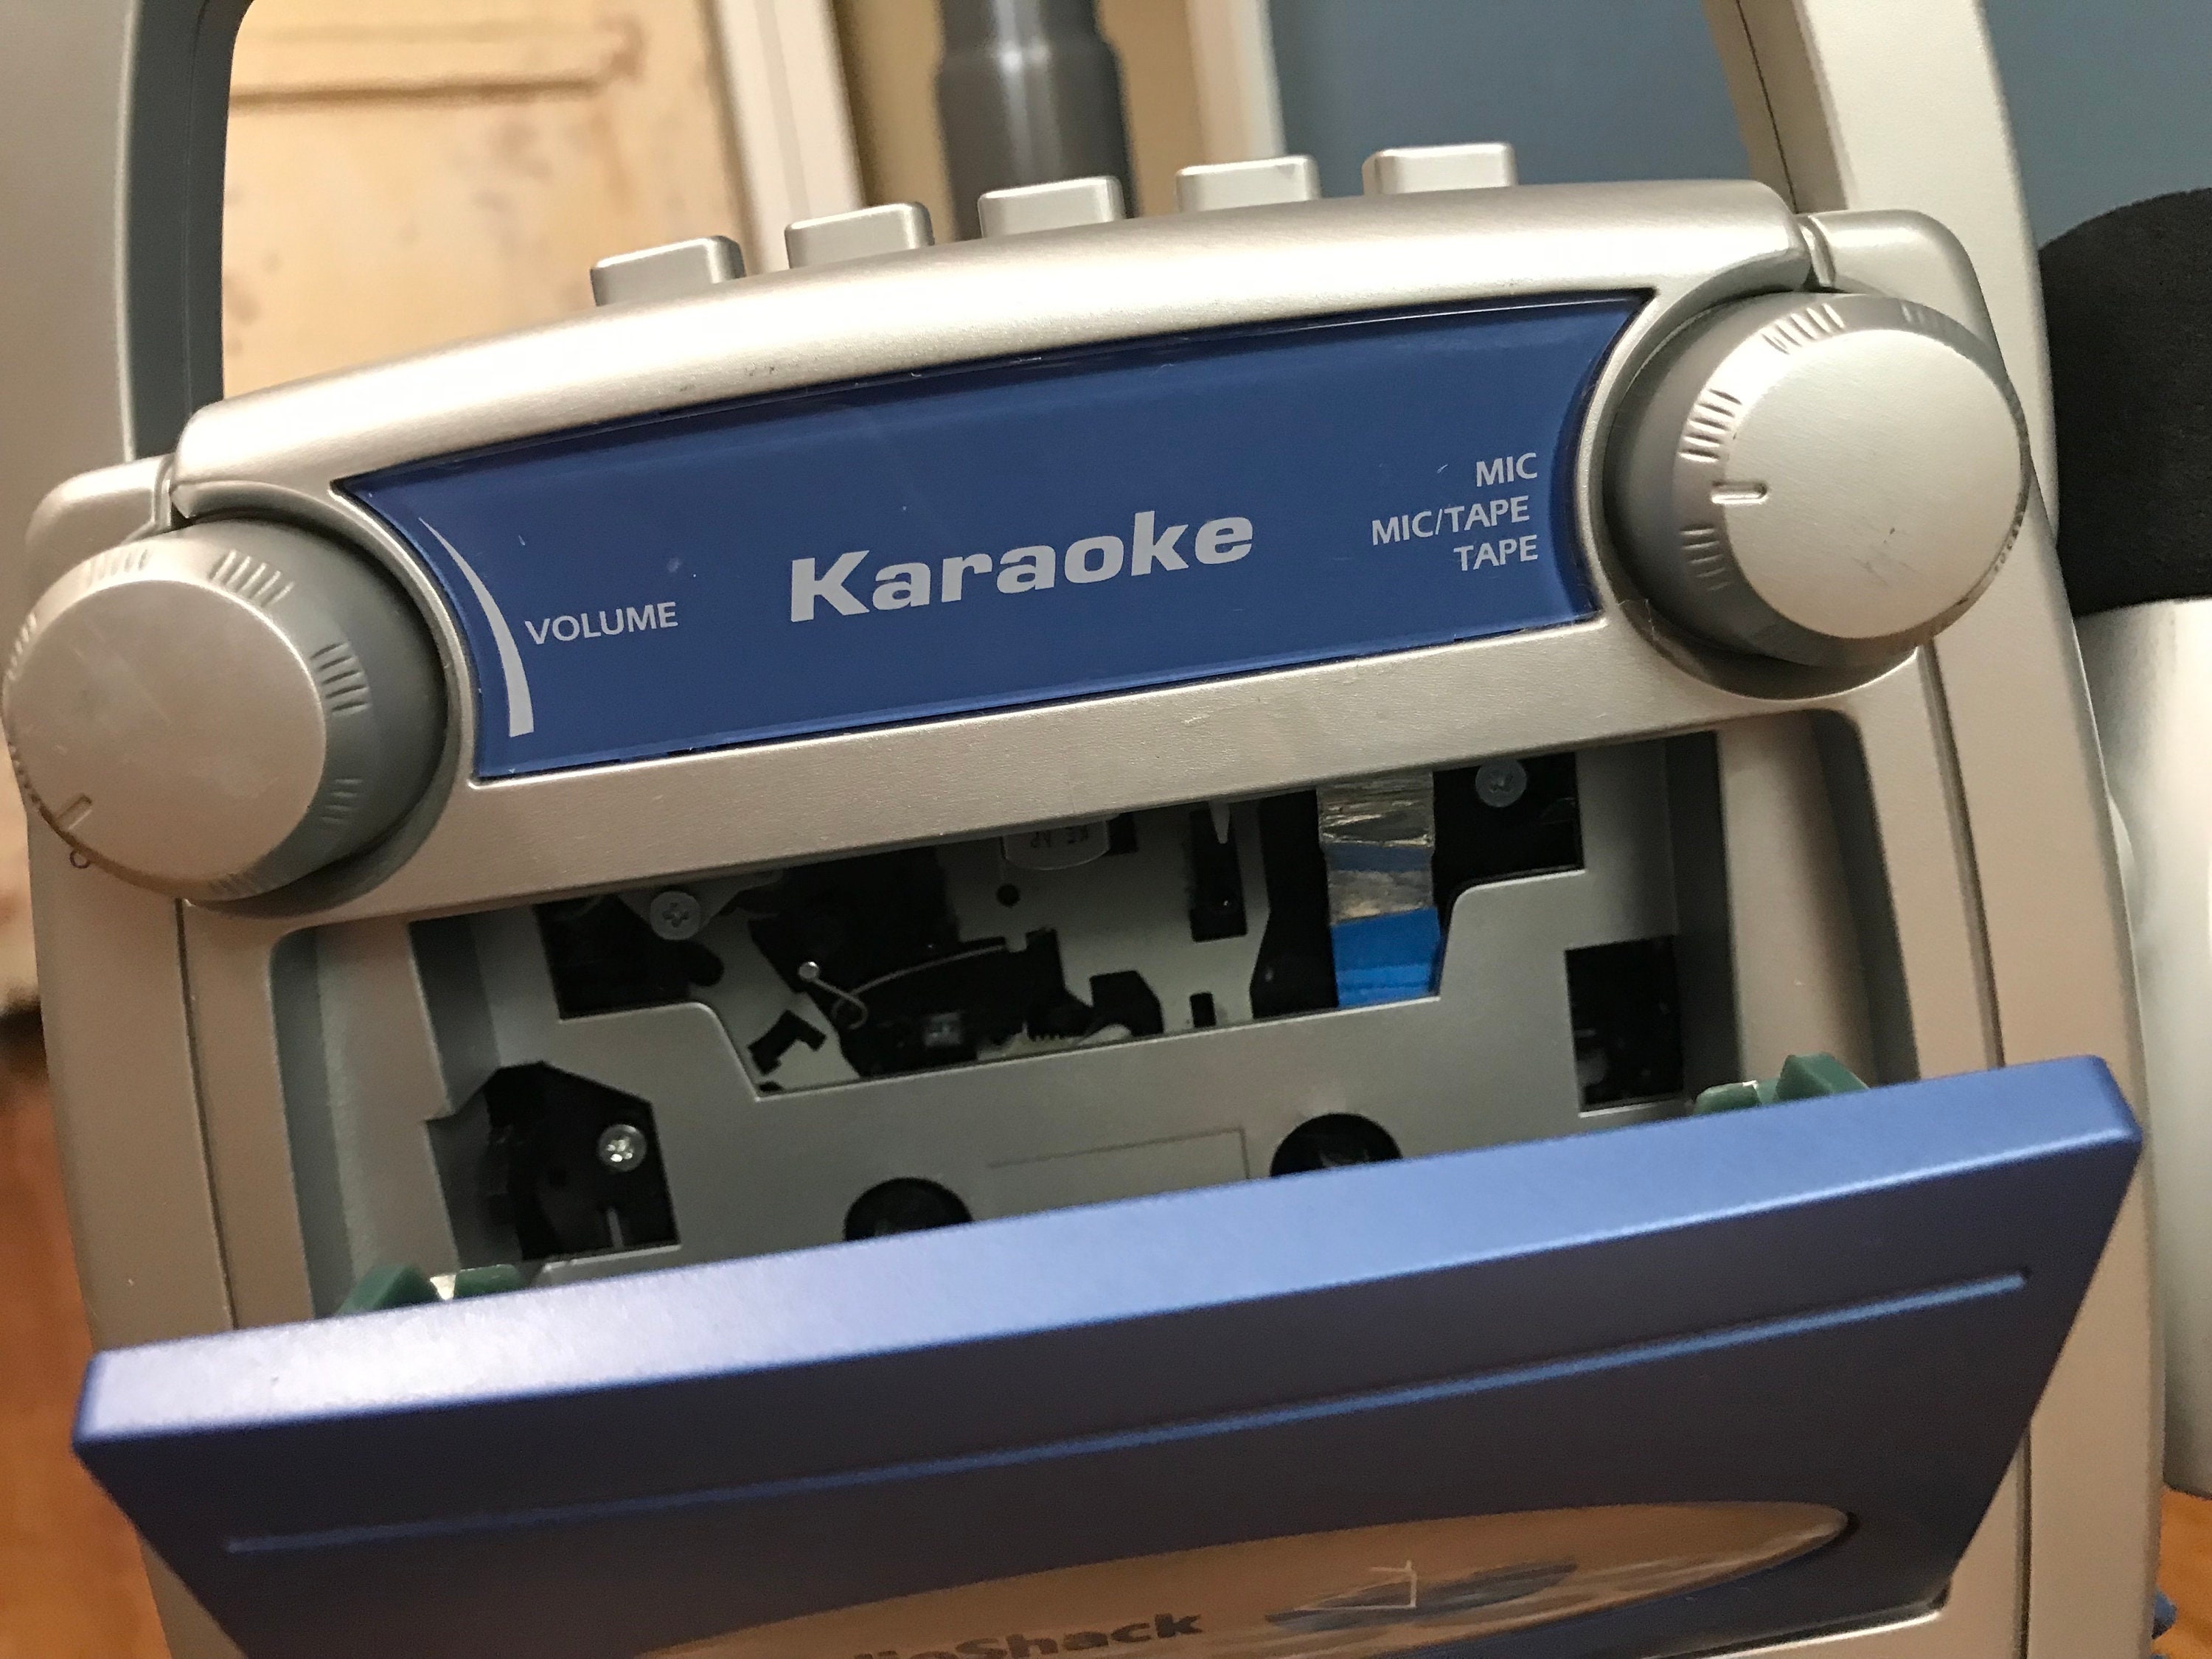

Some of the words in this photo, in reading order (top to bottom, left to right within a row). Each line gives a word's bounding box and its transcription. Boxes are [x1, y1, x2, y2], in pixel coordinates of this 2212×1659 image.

[1475, 452, 1538, 488] MIC
[1371, 495, 1530, 546] MIC/TAPE
[791, 510, 1253, 622] Karaoke
[1453, 534, 1538, 571] TAPE
[524, 601, 678, 645] VOLUME
